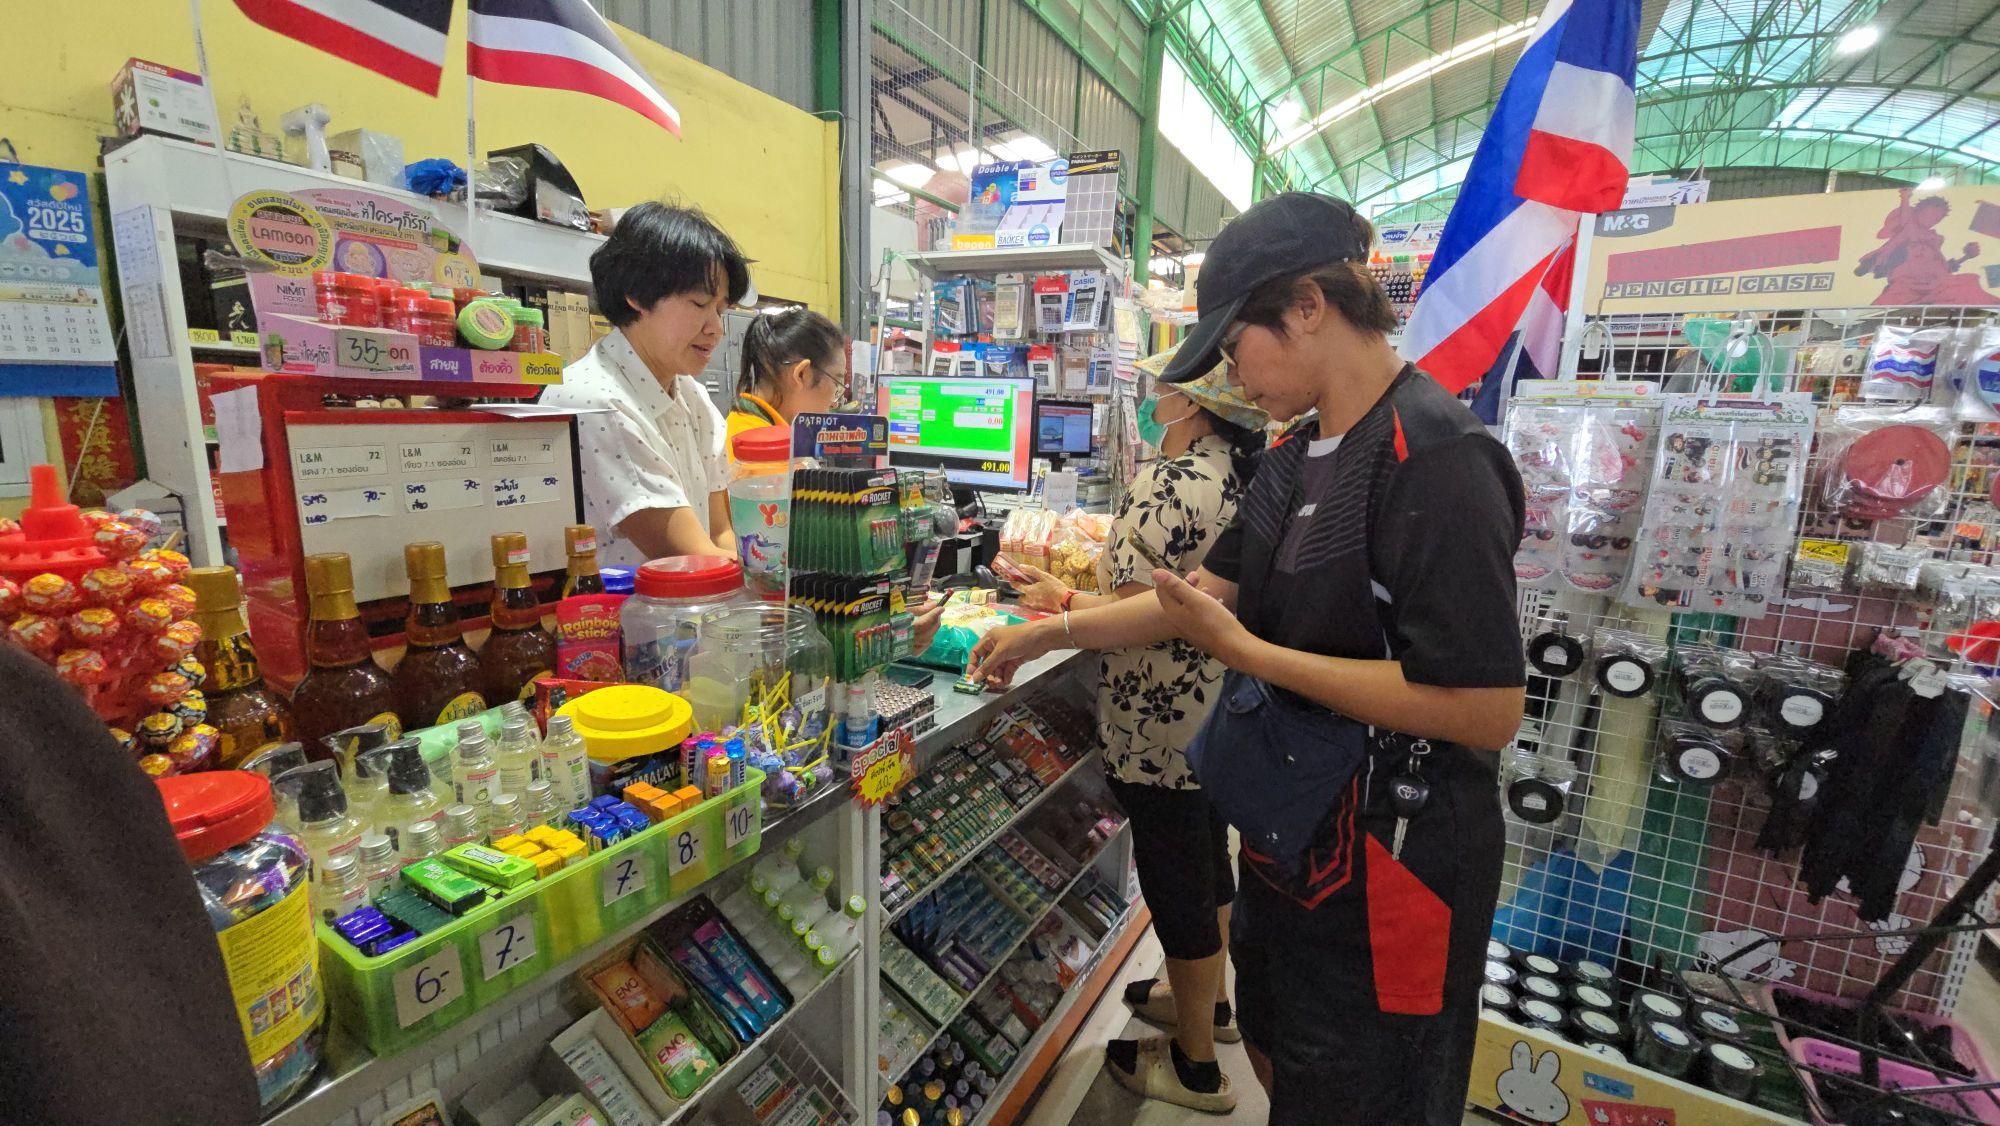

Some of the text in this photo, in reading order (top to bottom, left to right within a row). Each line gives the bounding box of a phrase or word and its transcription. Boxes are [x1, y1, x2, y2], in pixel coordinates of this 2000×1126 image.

[978, 163, 1010, 175] Double
[27, 207, 86, 233] 2025
[1603, 213, 1650, 232] M&G
[1073, 277, 1095, 286] CASIO
[1607, 275, 1832, 297] PENCIL CASE
[798, 415, 839, 426] PATRIOT
[402, 447, 471, 458] L&M 72
[492, 443, 509, 452] L&M
[300, 451, 380, 464] L&M 72
[981, 461, 1011, 473] 491.00
[519, 494, 526, 503] 2
[869, 491, 892, 503] ROCKET
[860, 598, 884, 612] ROCKET
[562, 616, 620, 633] Rainbow
[852, 731, 900, 778] Special
[614, 977, 639, 998] ENO
[655, 1032, 687, 1066] ENO
